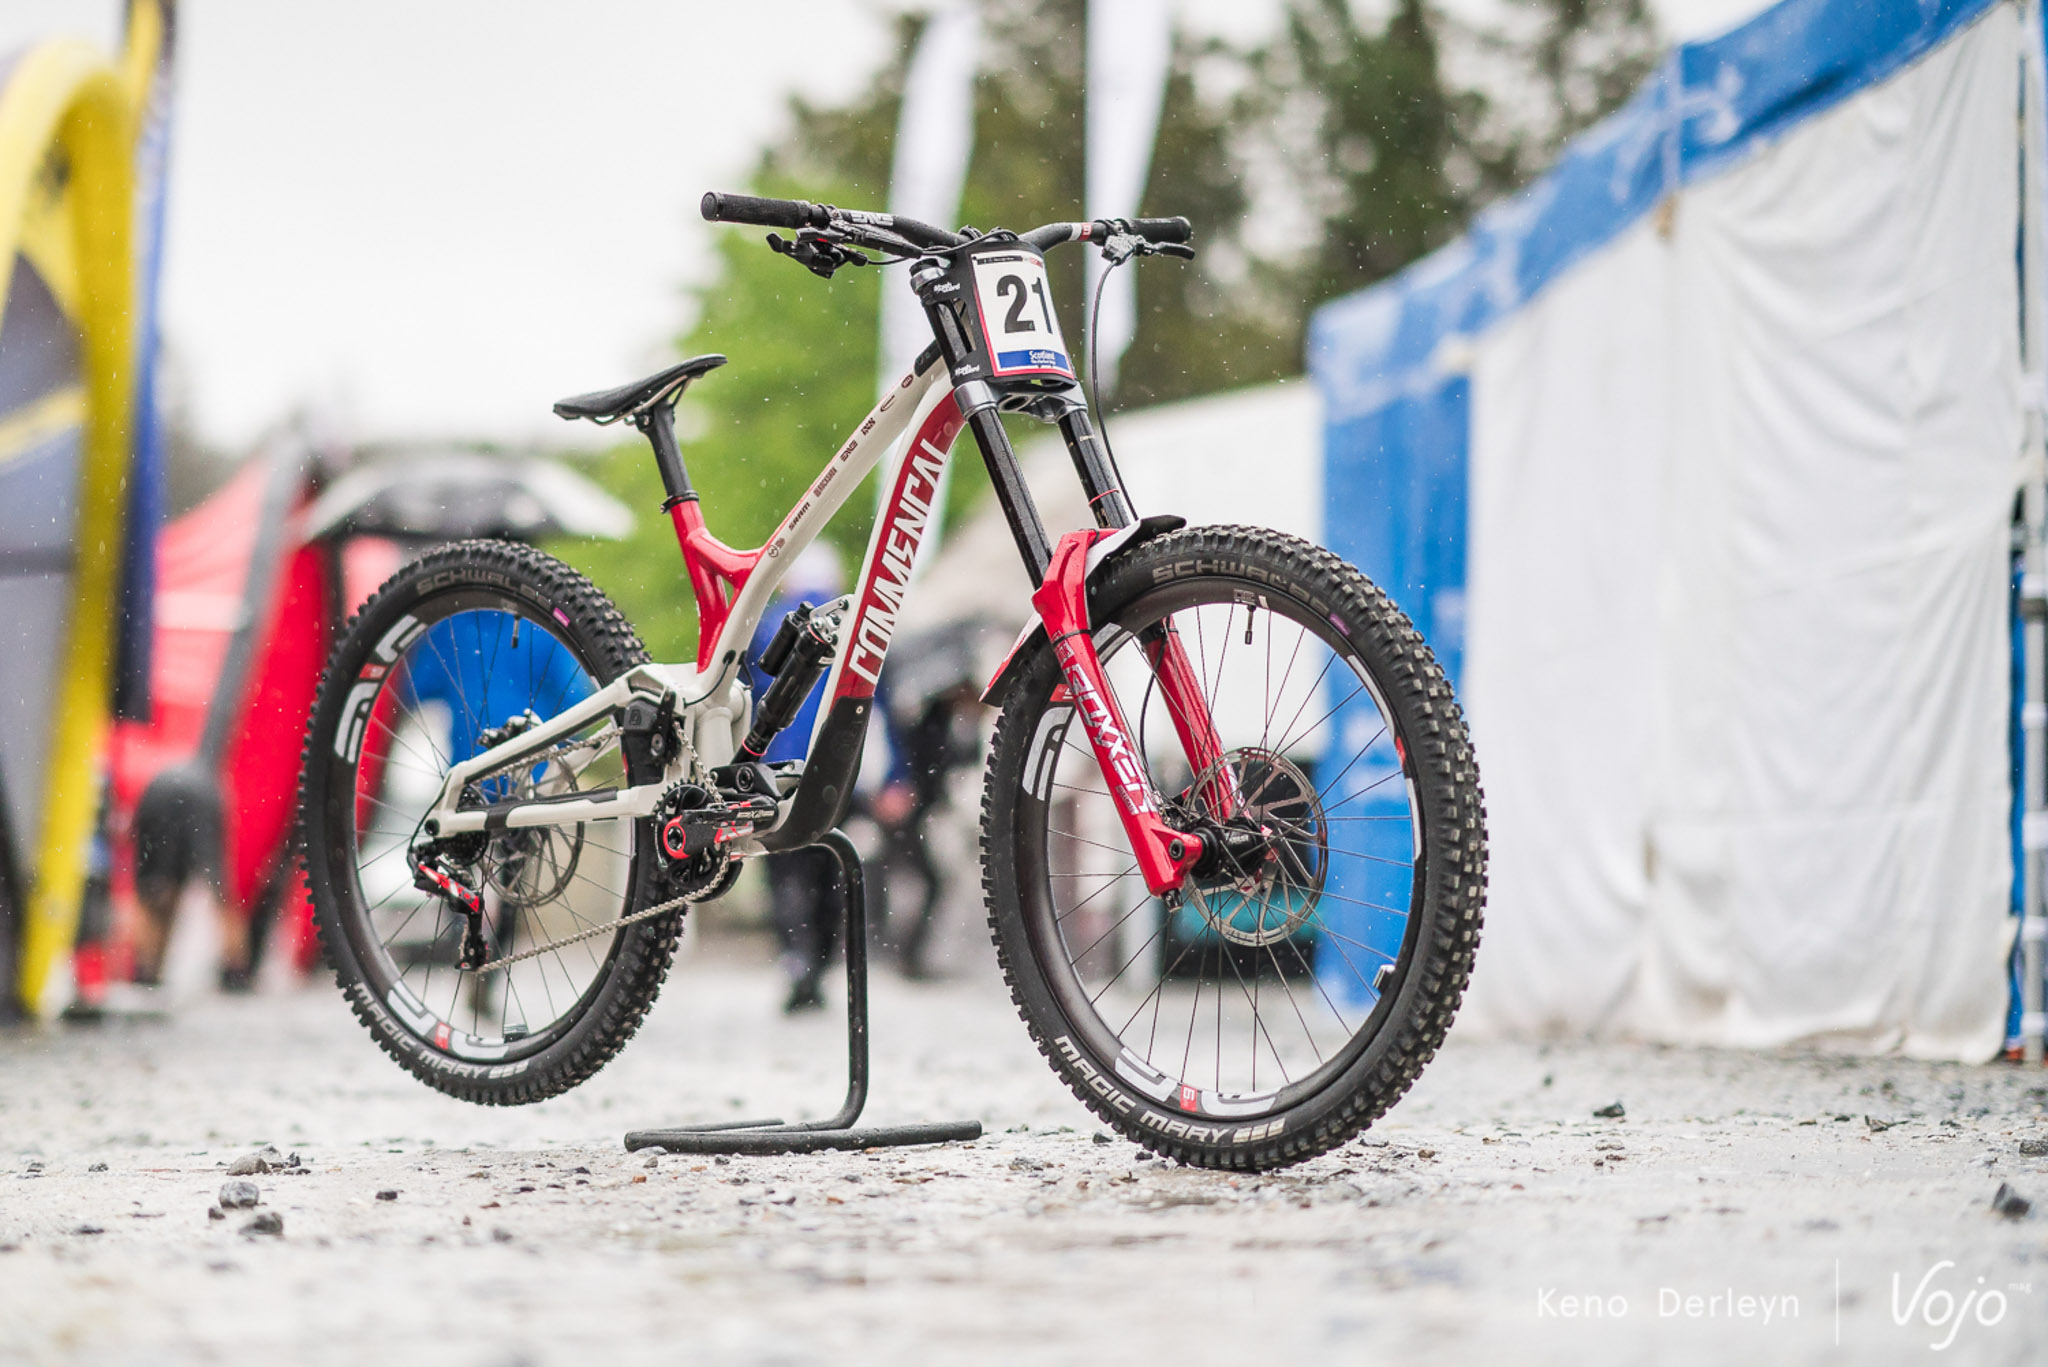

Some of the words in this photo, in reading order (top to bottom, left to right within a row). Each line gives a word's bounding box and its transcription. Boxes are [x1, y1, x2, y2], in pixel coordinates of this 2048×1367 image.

[996, 274, 1053, 334] 21
[1152, 558, 1330, 616] SCHWALBE
[1063, 662, 1159, 814] BOXXER
[353, 982, 418, 1051] MAGIC
[418, 1049, 488, 1079] MARY
[1054, 1034, 1137, 1114] MAGIC
[1139, 1109, 1231, 1144] MARY
